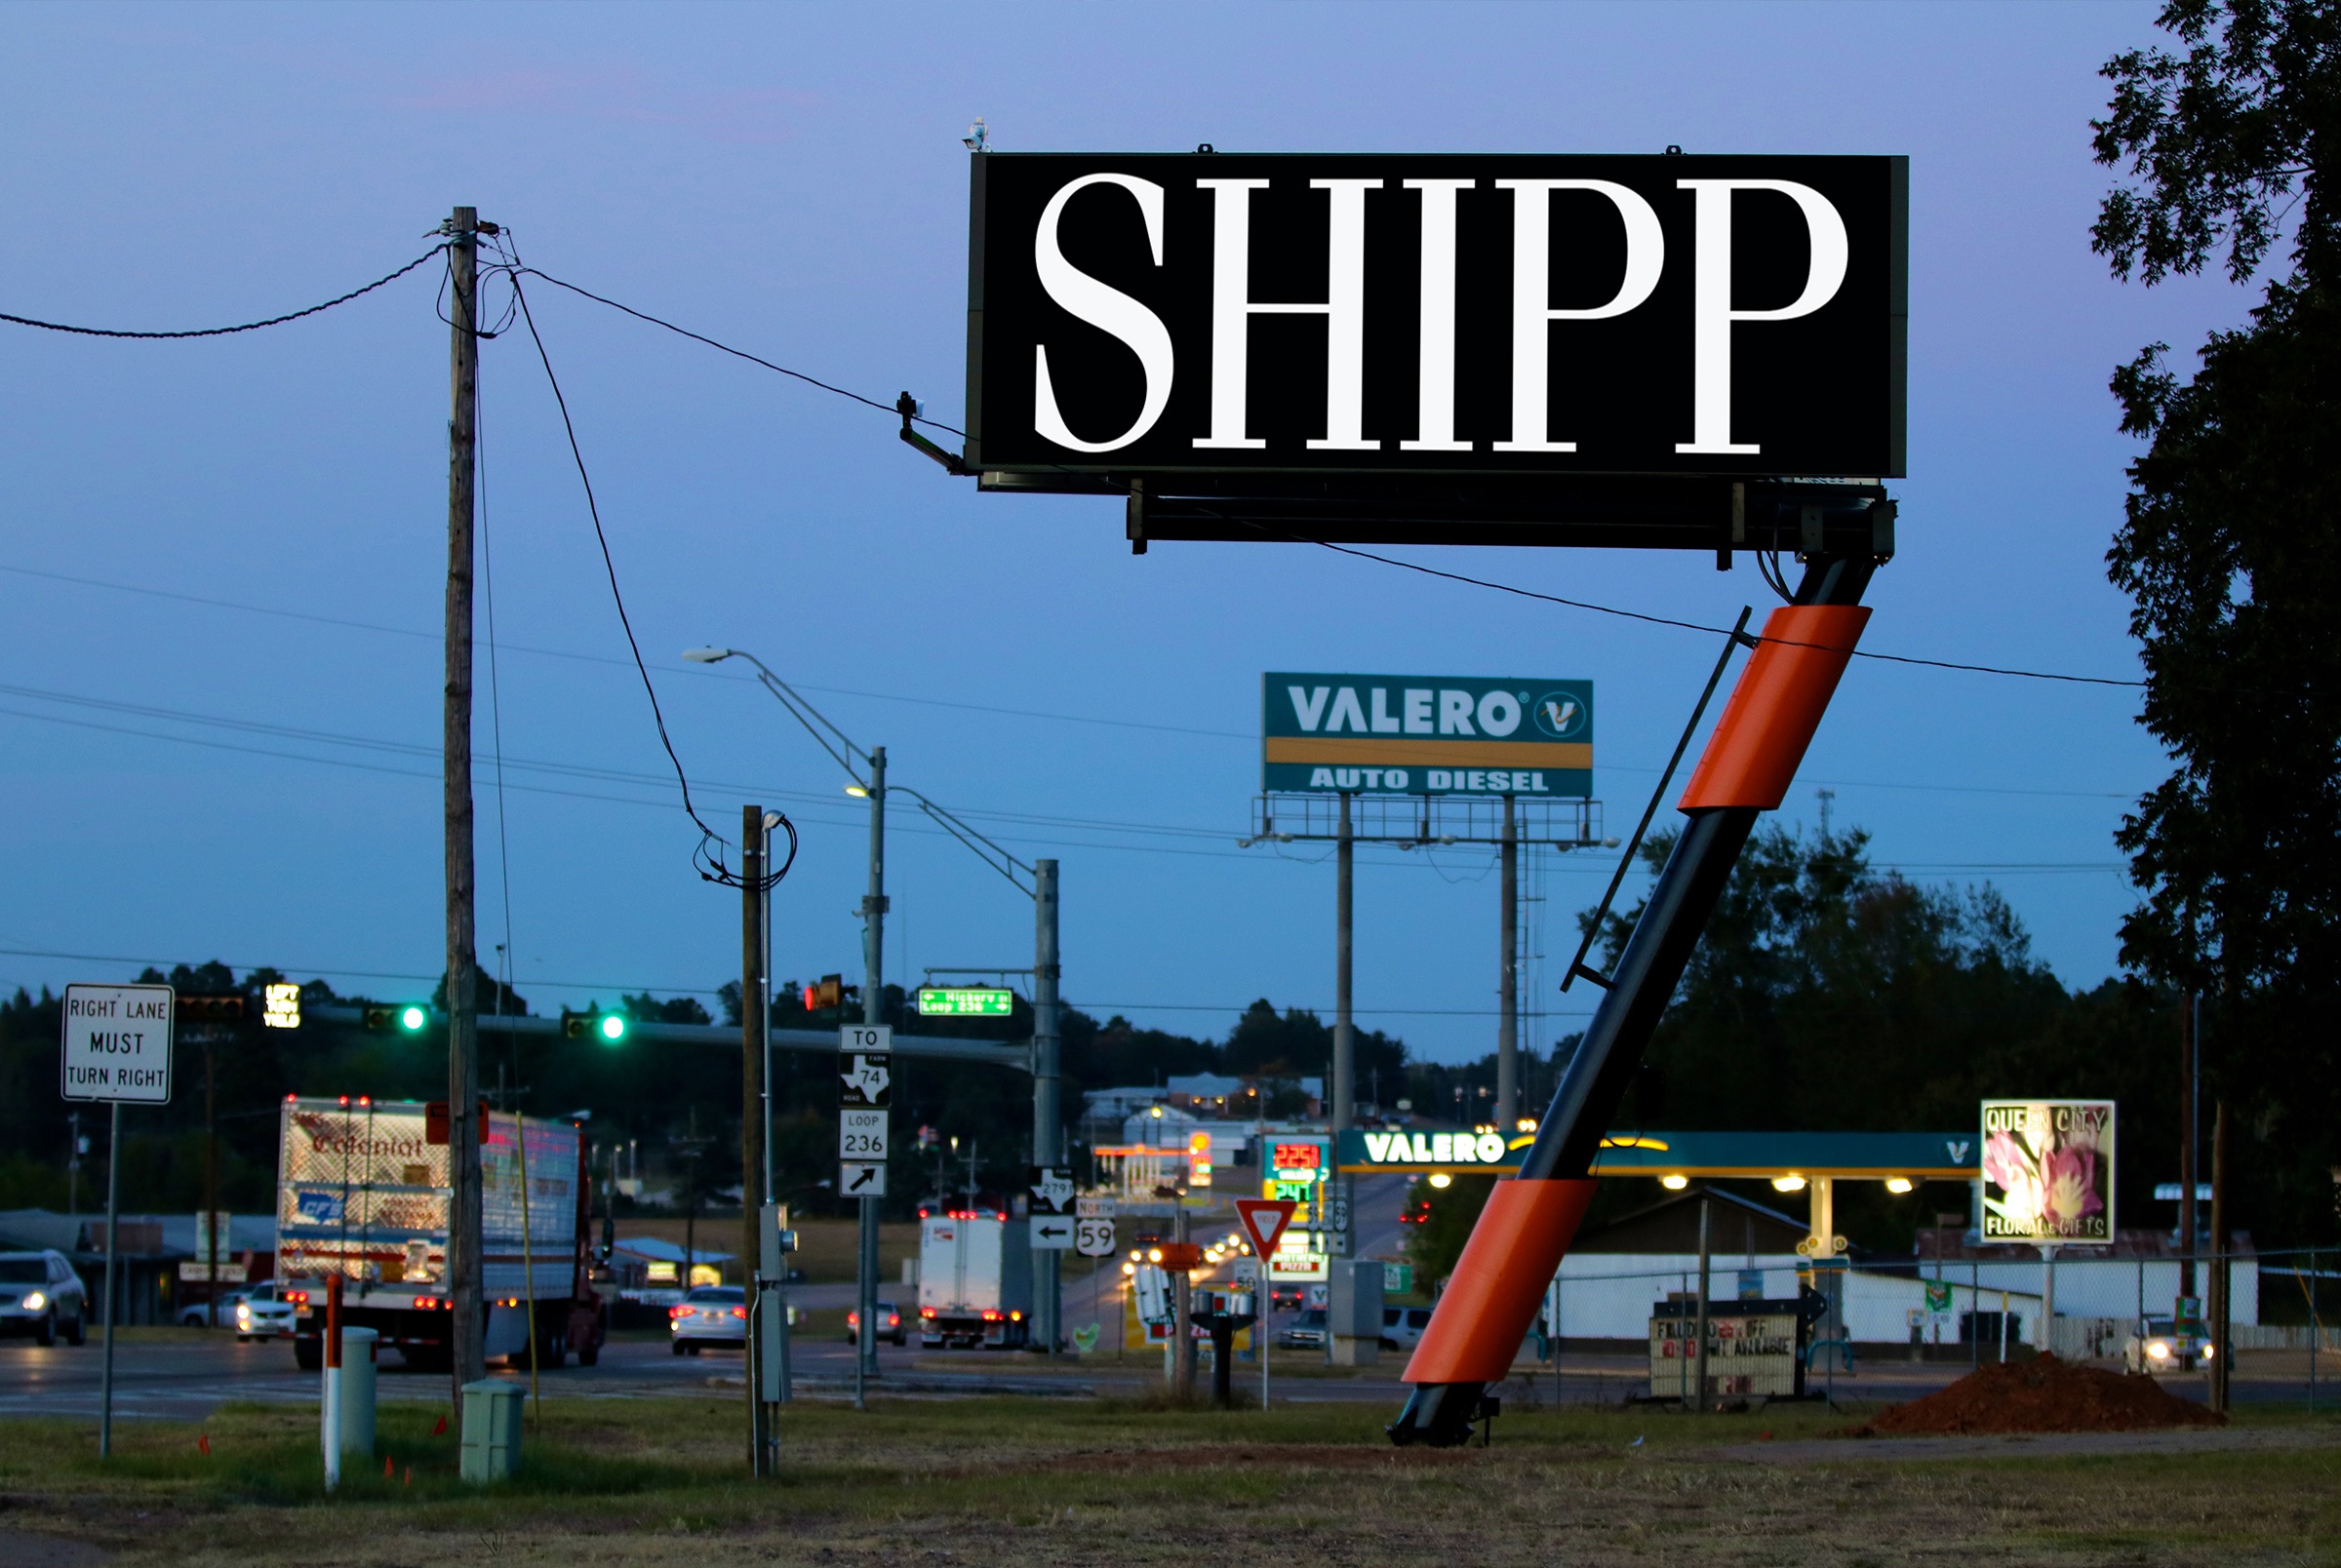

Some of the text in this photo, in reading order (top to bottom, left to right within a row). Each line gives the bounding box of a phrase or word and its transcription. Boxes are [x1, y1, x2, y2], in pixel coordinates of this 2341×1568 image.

[1034, 172, 1849, 455] SHIPP
[1288, 686, 1522, 737] VALERO
[1310, 767, 1549, 792] AUTO DIESEL
[265, 984, 300, 1000] LEFT
[945, 992, 996, 1002] Hickory
[69, 999, 167, 1020] RIGHT LANE
[922, 1001, 984, 1012] Loop 236
[90, 1032, 143, 1055] MUST
[853, 1031, 878, 1045] TO
[67, 1066, 165, 1087] TURN RIGHT
[860, 1070, 881, 1085] 74
[848, 1116, 880, 1126] LOOP
[1987, 1109, 2106, 1132] QUEEN CITY
[845, 1134, 883, 1153] 236
[1364, 1131, 1506, 1163] VALERO
[1043, 1183, 1073, 1196] 2791
[302, 1200, 342, 1216] CFS
[1080, 1201, 1114, 1215] NORTH
[1987, 1217, 2044, 1235] FLORAL
[2059, 1217, 2105, 1235] GIFTS
[1081, 1227, 1112, 1247] 59
[1281, 1263, 1312, 1272] PIZZA
